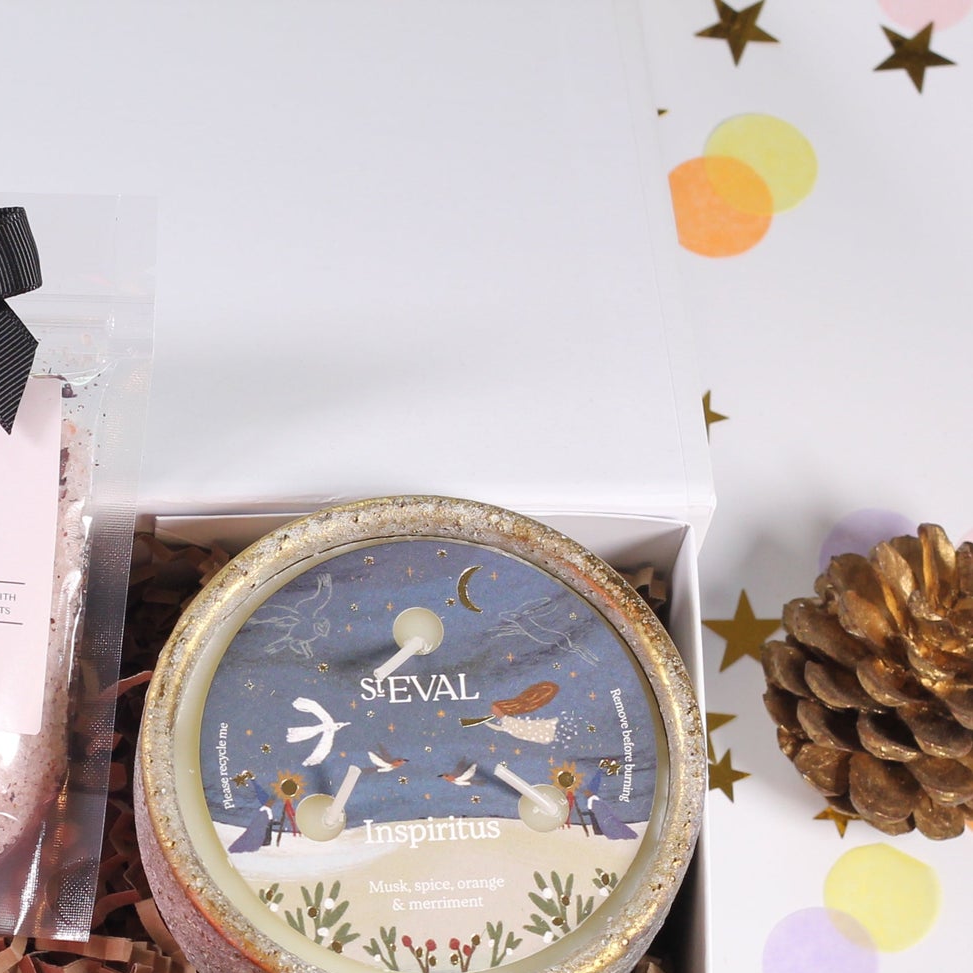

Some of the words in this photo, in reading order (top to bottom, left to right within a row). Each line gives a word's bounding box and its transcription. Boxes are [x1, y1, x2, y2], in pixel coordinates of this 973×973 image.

[610, 687, 629, 729] Remove
[219, 722, 229, 739] me
[622, 730, 635, 763] before
[215, 740, 230, 776] recycle
[221, 777, 235, 810] Please
[619, 764, 635, 803] burning
[363, 815, 502, 849] Inspiritus
[368, 879, 412, 894] Musk,
[414, 878, 455, 894] spice,
[456, 877, 505, 891] orange
[392, 897, 406, 911] &
[408, 896, 484, 911] merriment
